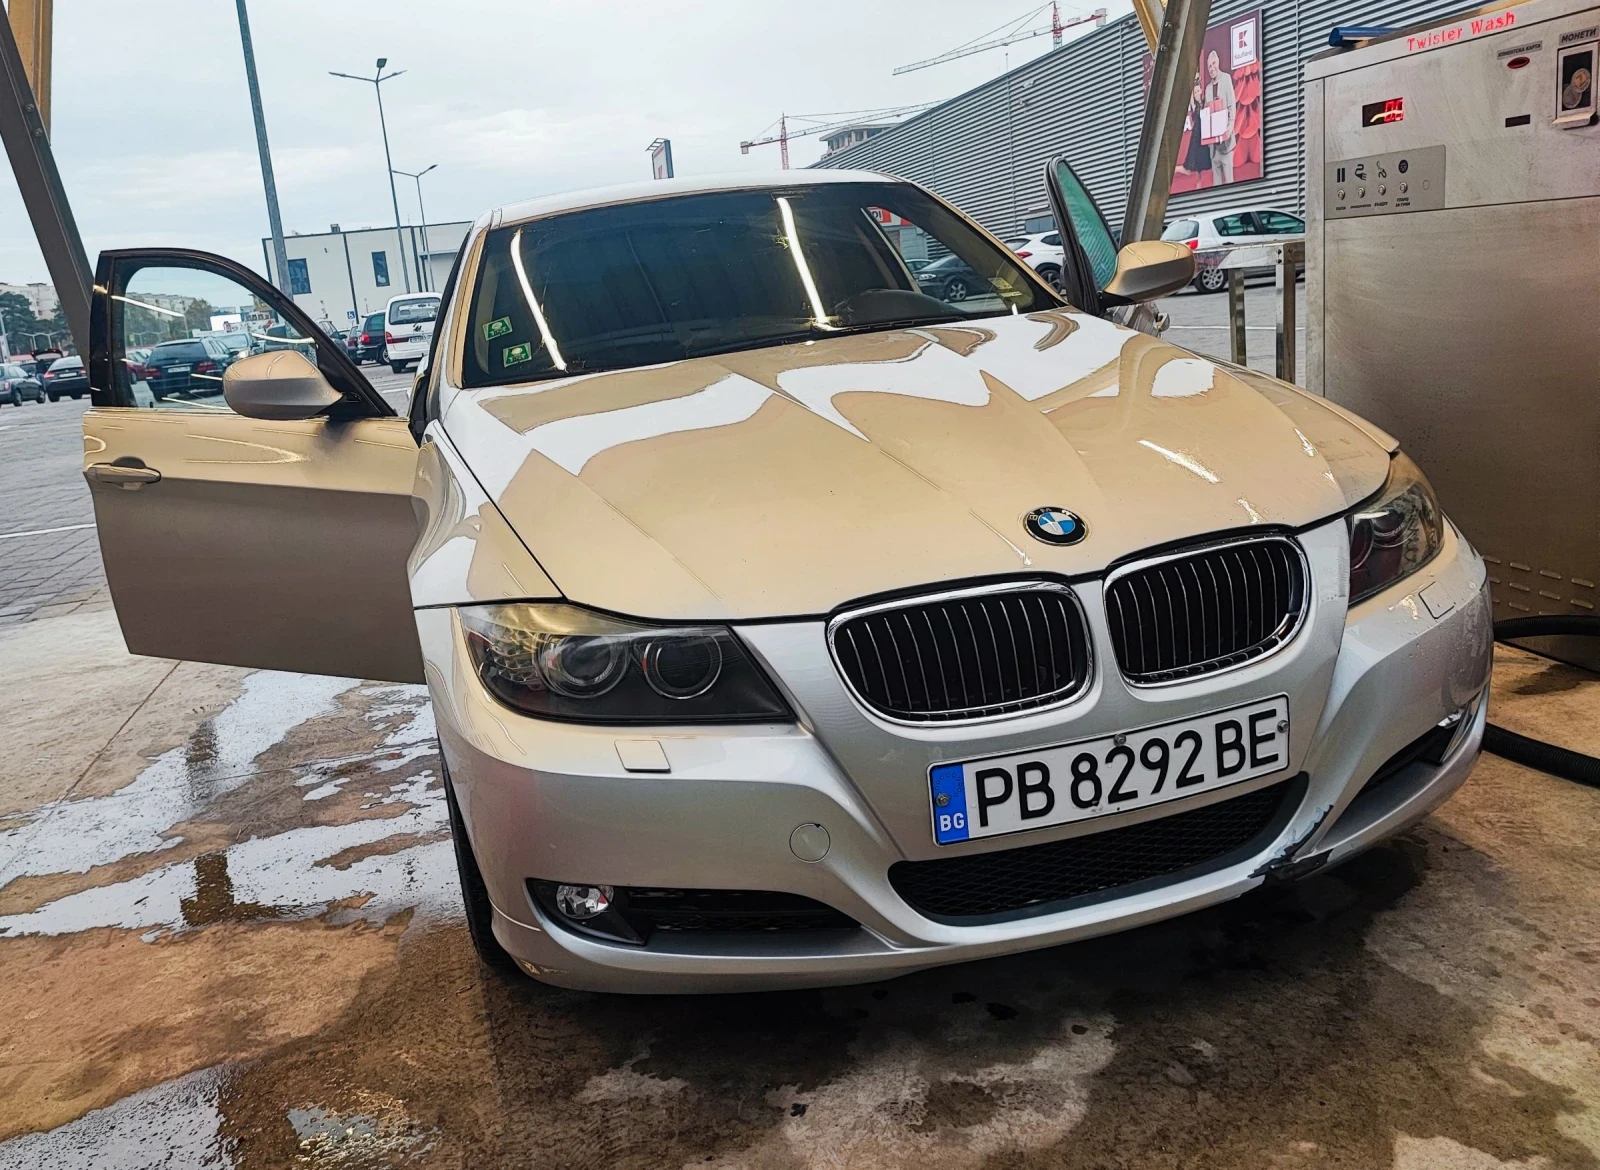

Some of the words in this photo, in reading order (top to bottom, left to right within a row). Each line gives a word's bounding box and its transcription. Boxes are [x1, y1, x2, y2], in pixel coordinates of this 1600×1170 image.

[1407, 27, 1463, 52] Twister
[1470, 11, 1516, 36] Wash
[1561, 28, 1597, 43] МОНЕТИ
[975, 761, 1055, 828] PB
[1069, 730, 1205, 810] 8292
[1214, 708, 1280, 779] BE
[939, 812, 965, 832] BG
